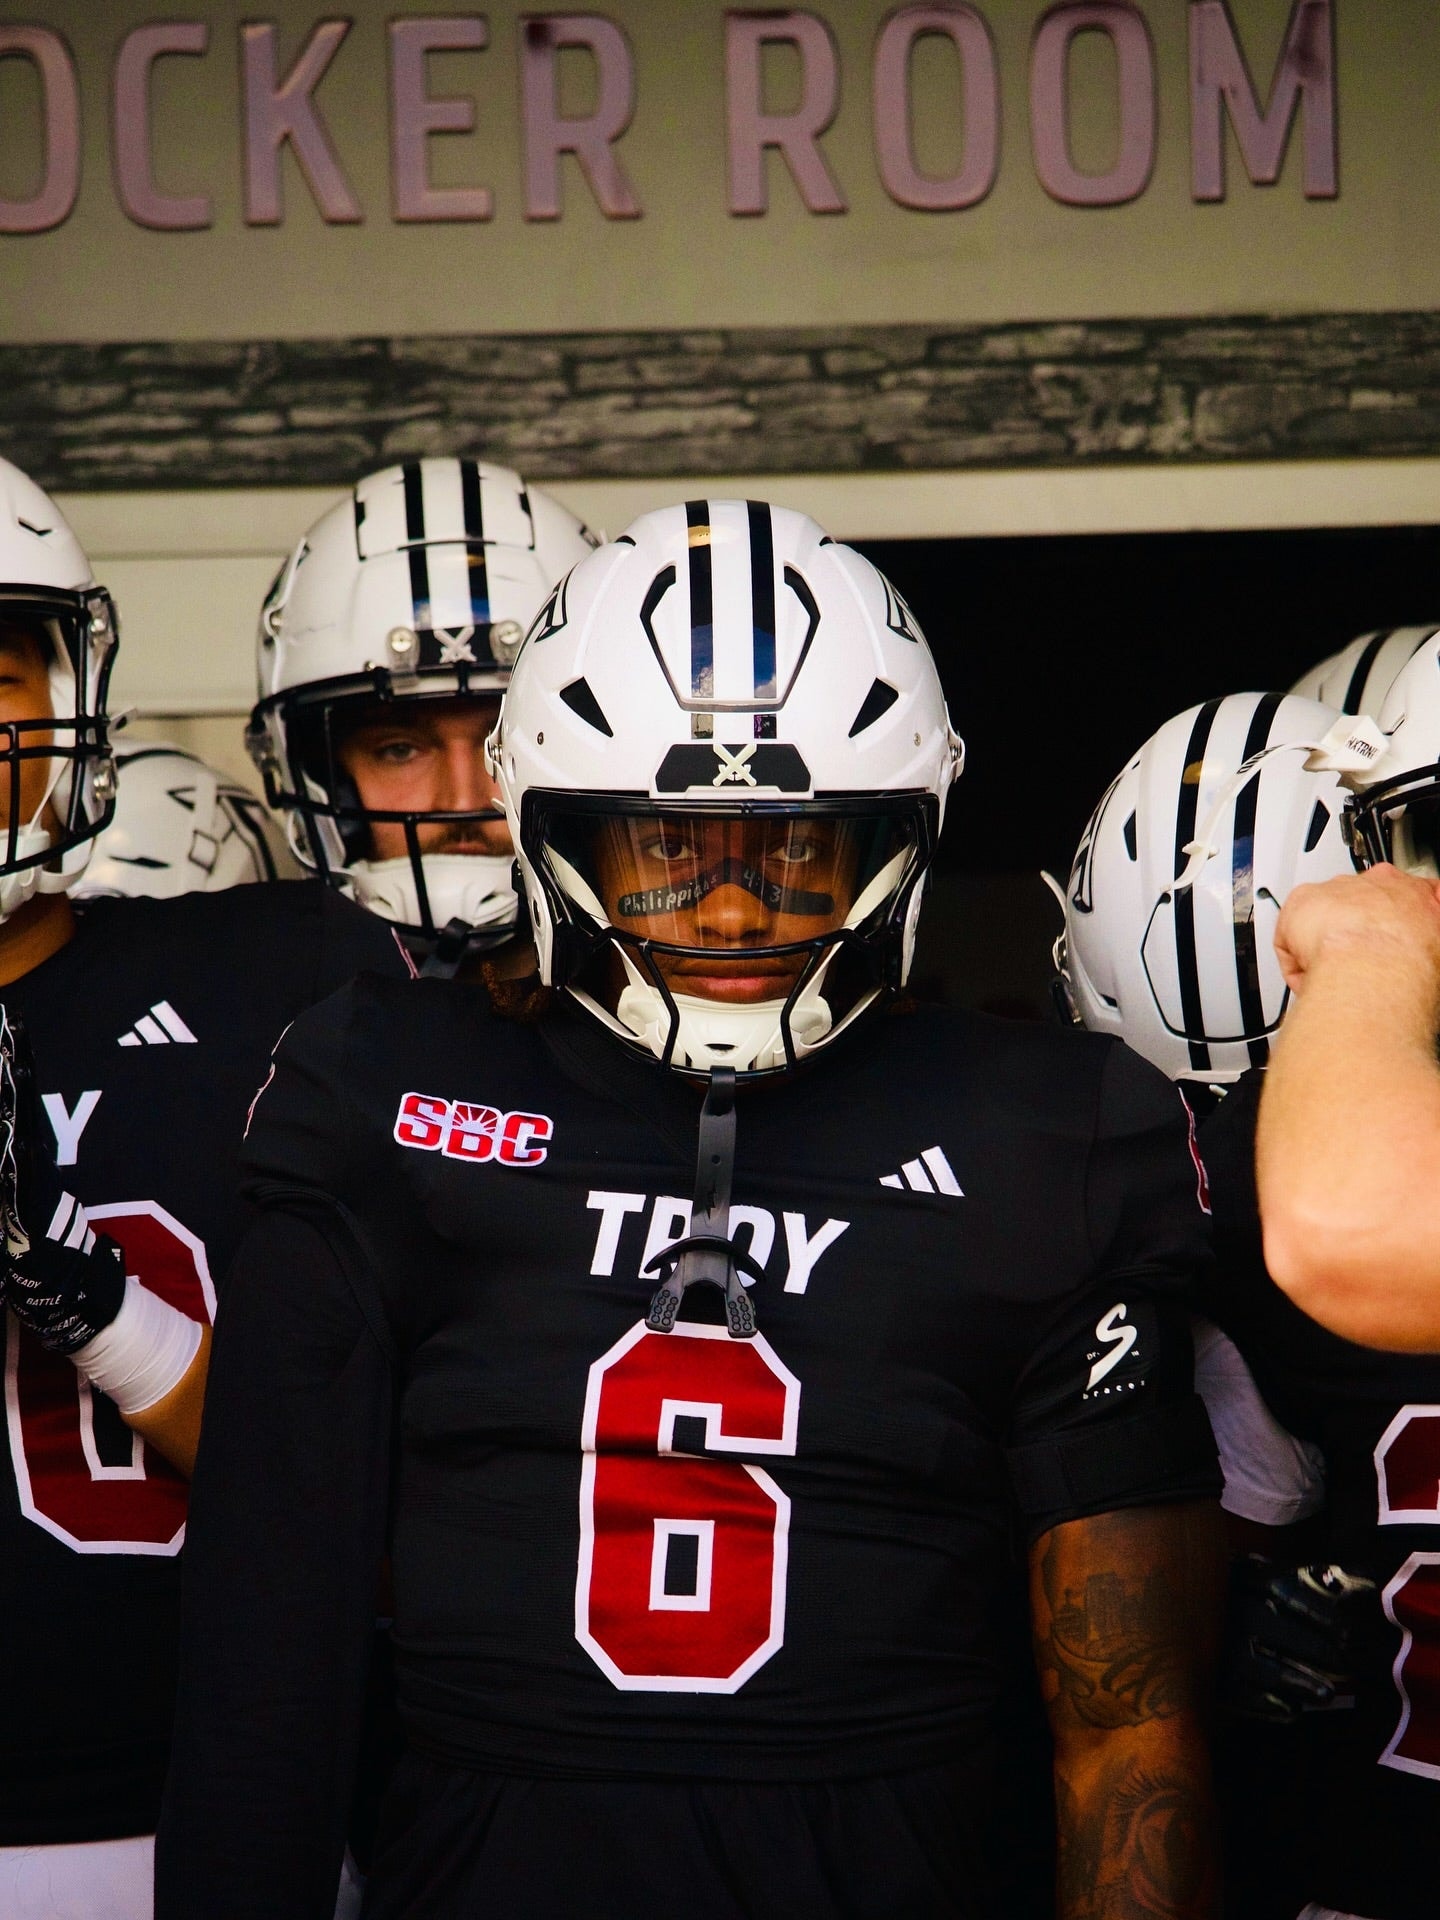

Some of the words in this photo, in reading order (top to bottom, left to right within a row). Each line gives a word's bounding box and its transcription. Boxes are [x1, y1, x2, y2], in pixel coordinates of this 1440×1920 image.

[725, 0, 1339, 216] ROOM
[623, 873, 717, 913] Philippians
[394, 1091, 554, 1167] SBC
[11, 1272, 42, 1289] READY
[586, 1190, 851, 1295] TROY
[26, 1294, 62, 1306] BATTLE
[575, 1317, 802, 1695] 6
